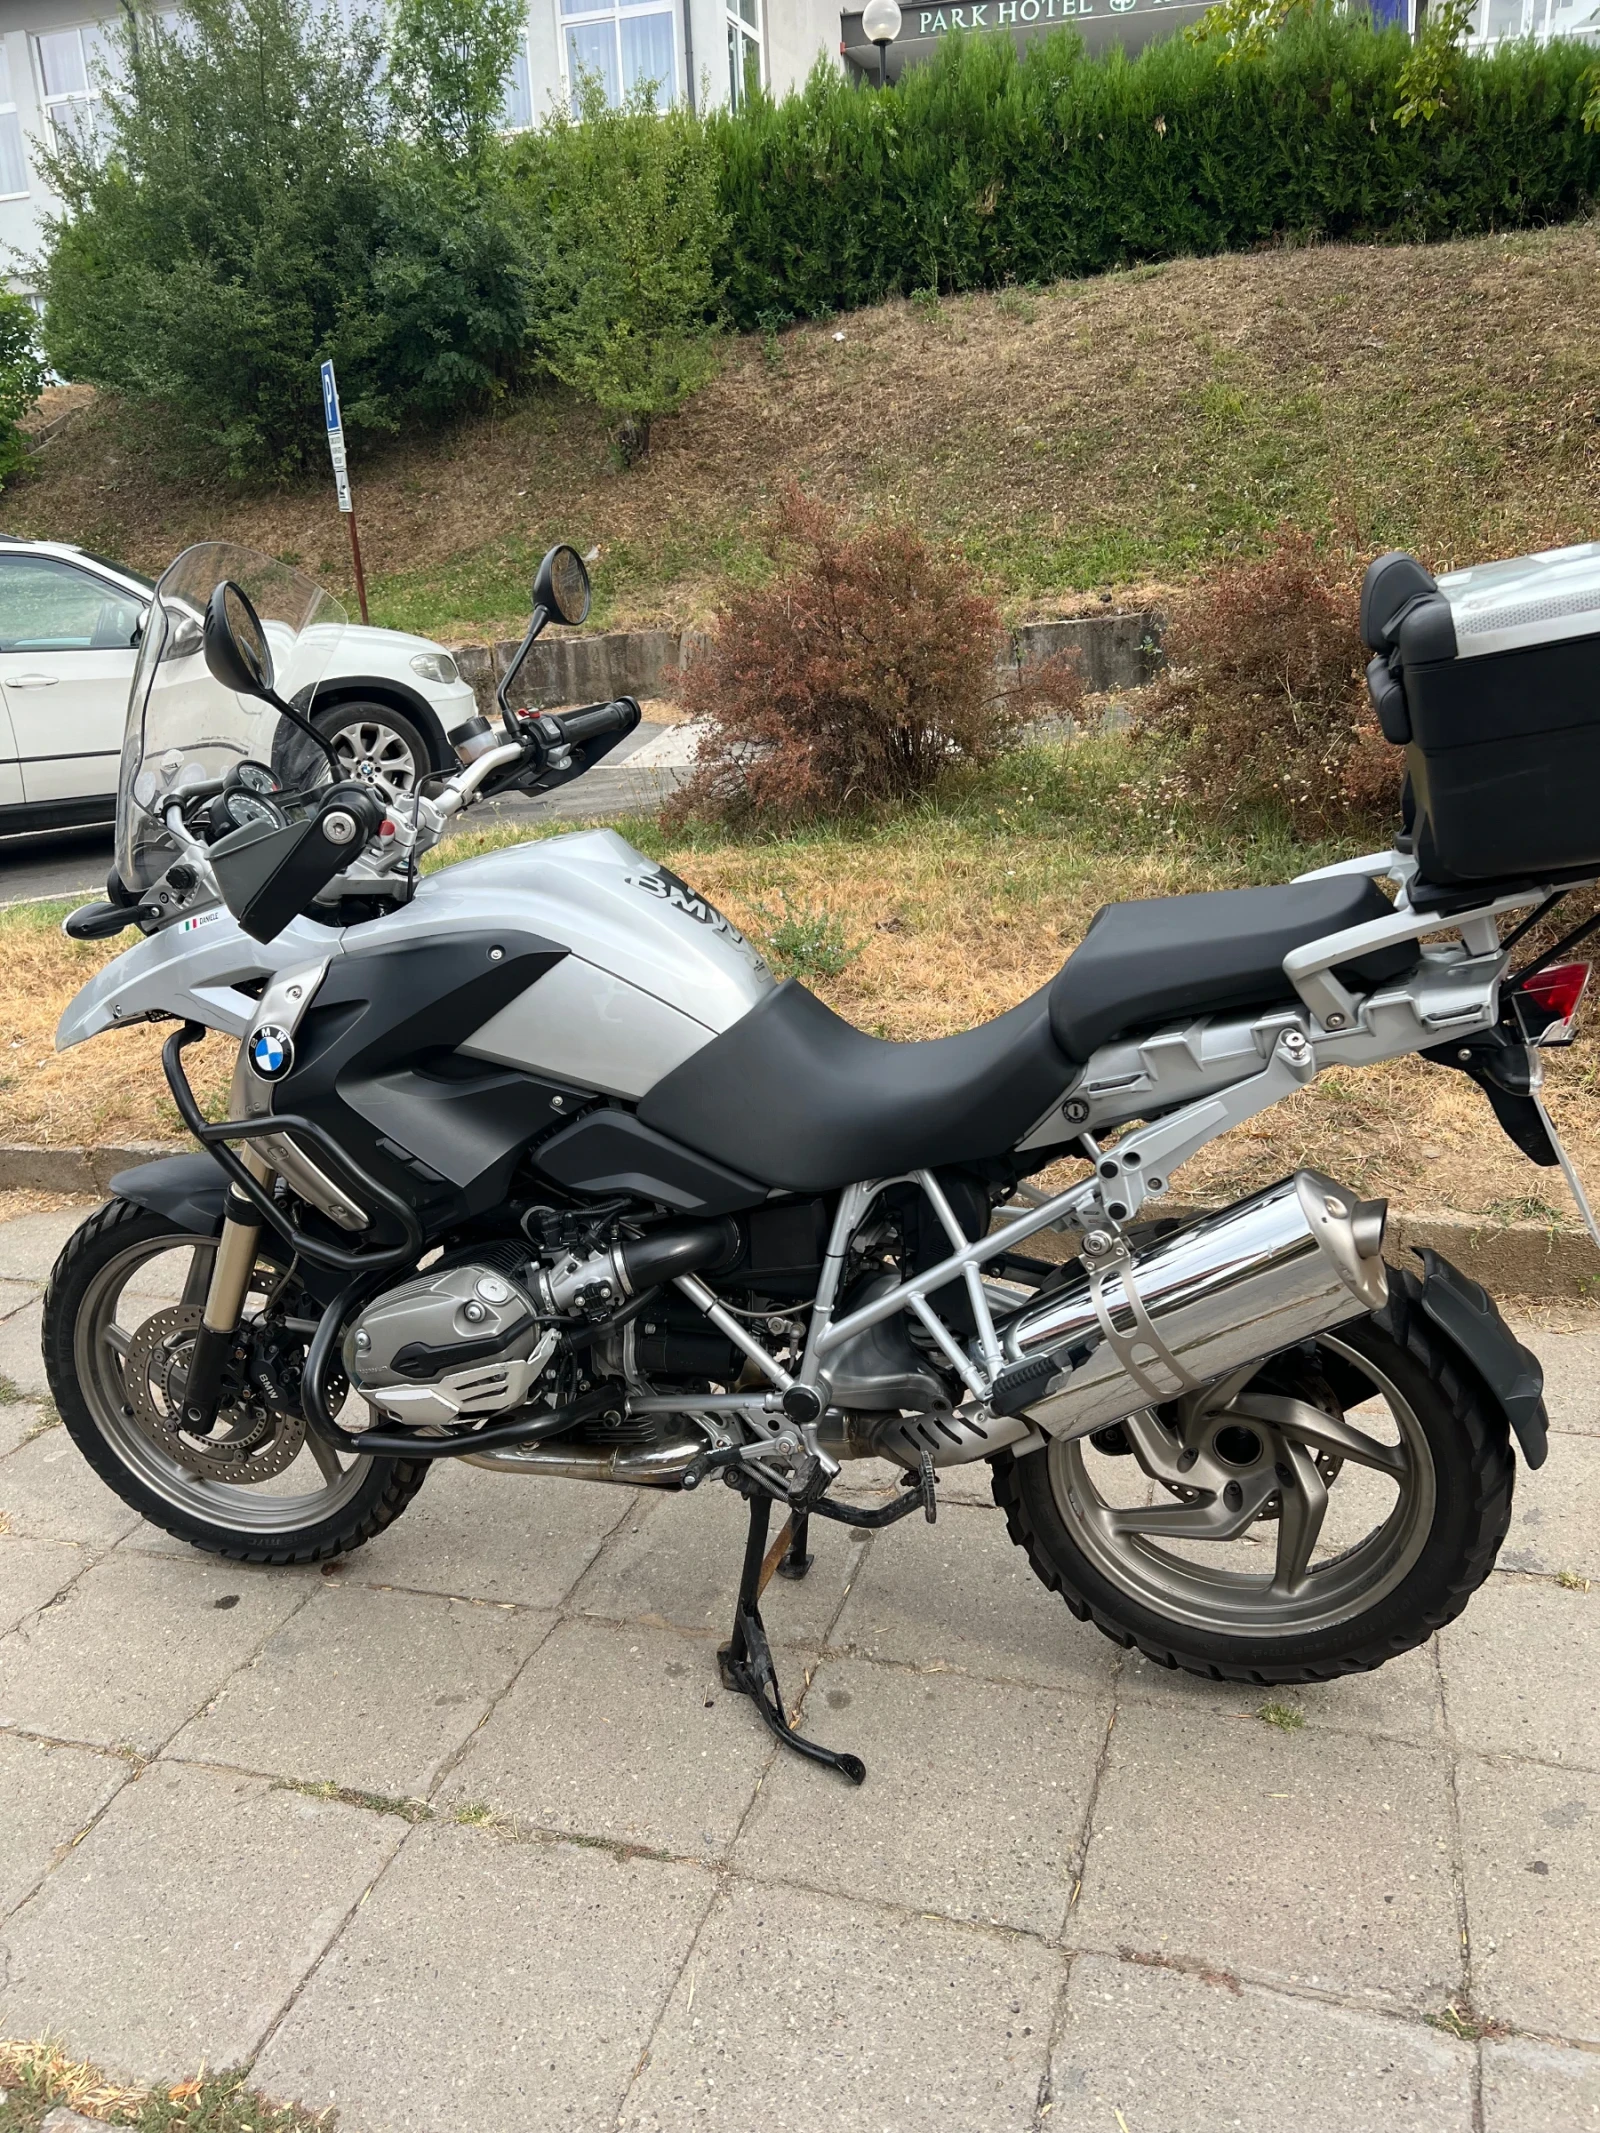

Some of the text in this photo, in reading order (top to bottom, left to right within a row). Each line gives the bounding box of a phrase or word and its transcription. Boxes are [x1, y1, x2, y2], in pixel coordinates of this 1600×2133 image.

[919, 0, 1093, 34] PARK HOTEL
[324, 374, 333, 421] P
[199, 911, 219, 925] DANIELE
[626, 874, 743, 945] BMW
[250, 1027, 287, 1050] BMW
[259, 1373, 279, 1399] BMW
